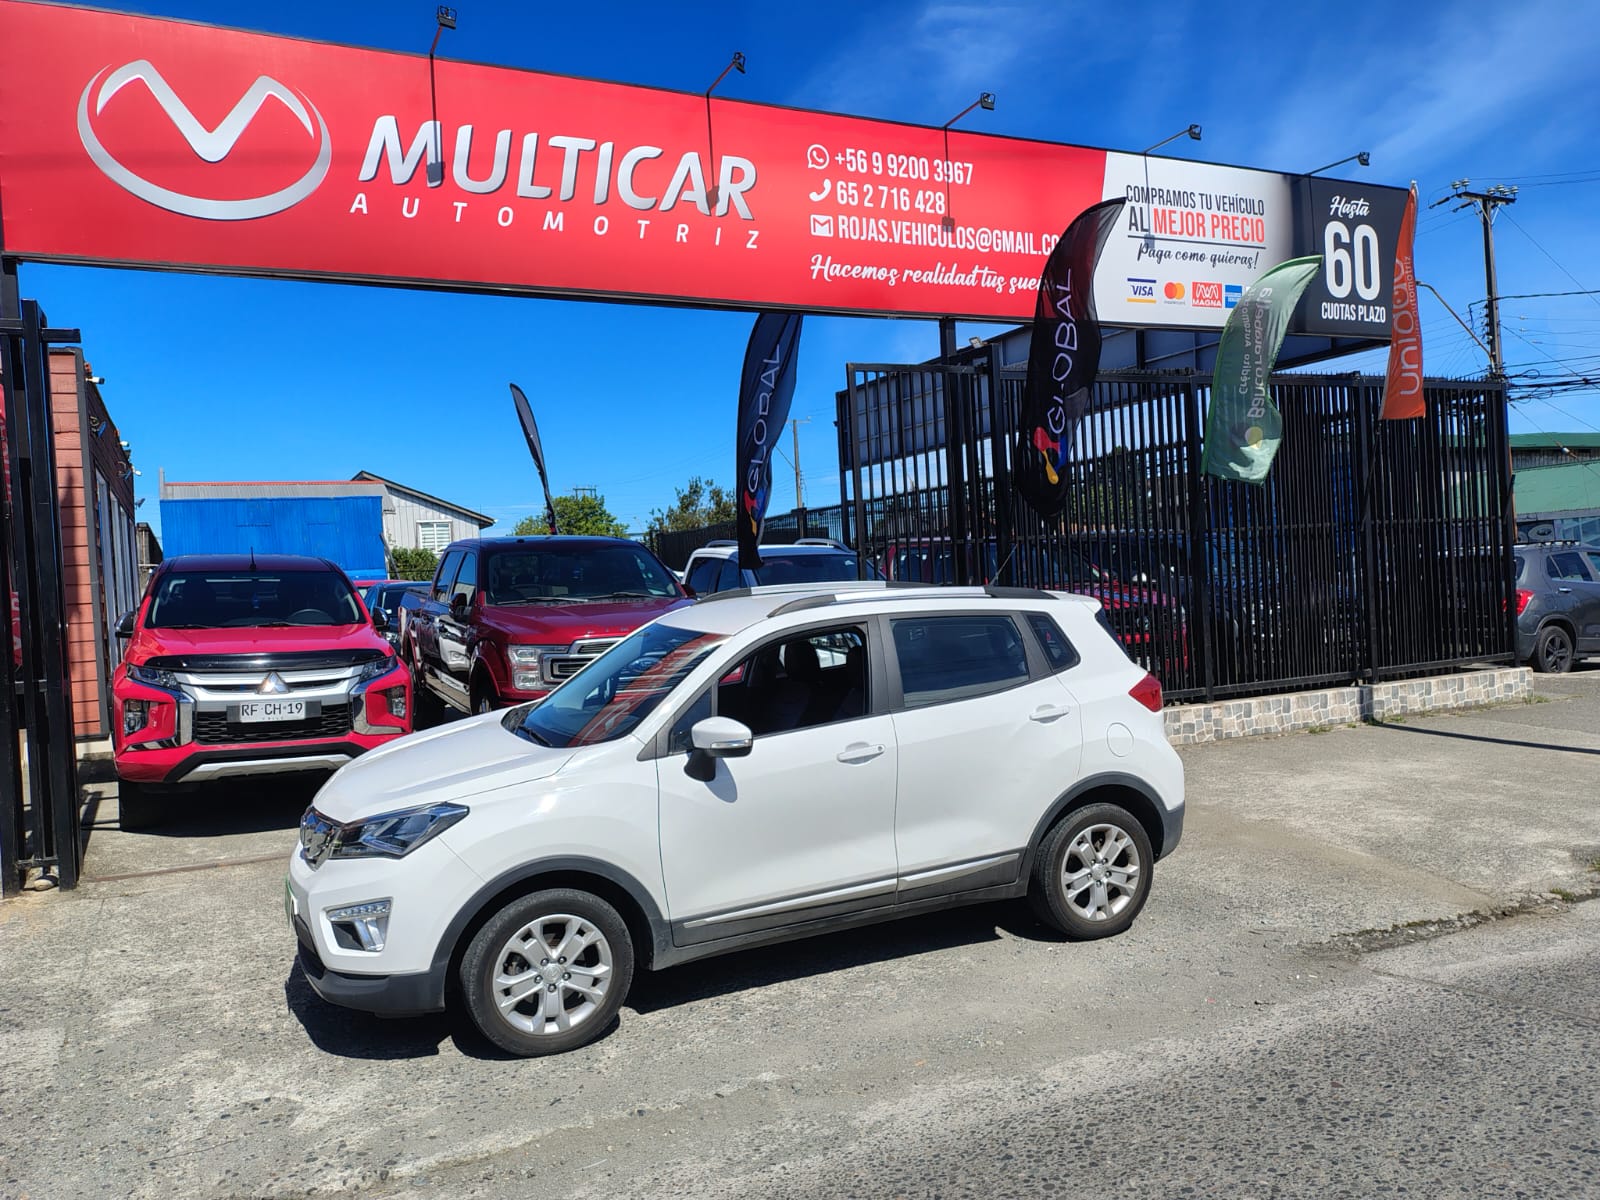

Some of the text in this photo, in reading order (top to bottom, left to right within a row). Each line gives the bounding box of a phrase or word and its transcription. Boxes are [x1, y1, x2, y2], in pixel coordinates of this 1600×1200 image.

[358, 114, 757, 220] MULTICAR
[834, 147, 974, 185] +56 9 9200 3967
[836, 180, 946, 215] 65 2 716 428
[1126, 184, 1265, 216] COMPRAMOS TU VEHÍCULO
[1329, 195, 1370, 219] Hasta
[350, 192, 760, 250] AUTOMOTRIZ
[838, 214, 1060, 256] ROJAS.VEHICULOS@GMAIL.CO
[1128, 205, 1265, 243] AL MEJOR PRECIO
[810, 254, 899, 287] Hacemos
[902, 261, 979, 288] realidad
[976, 265, 1007, 293] tus
[1175, 251, 1205, 262] como
[1209, 251, 1259, 269] quieras!
[1324, 220, 1381, 301] 60
[1132, 285, 1154, 297] VISA
[1192, 298, 1222, 307] MAGNA
[1321, 302, 1386, 323] CUOTAS PLAZO
